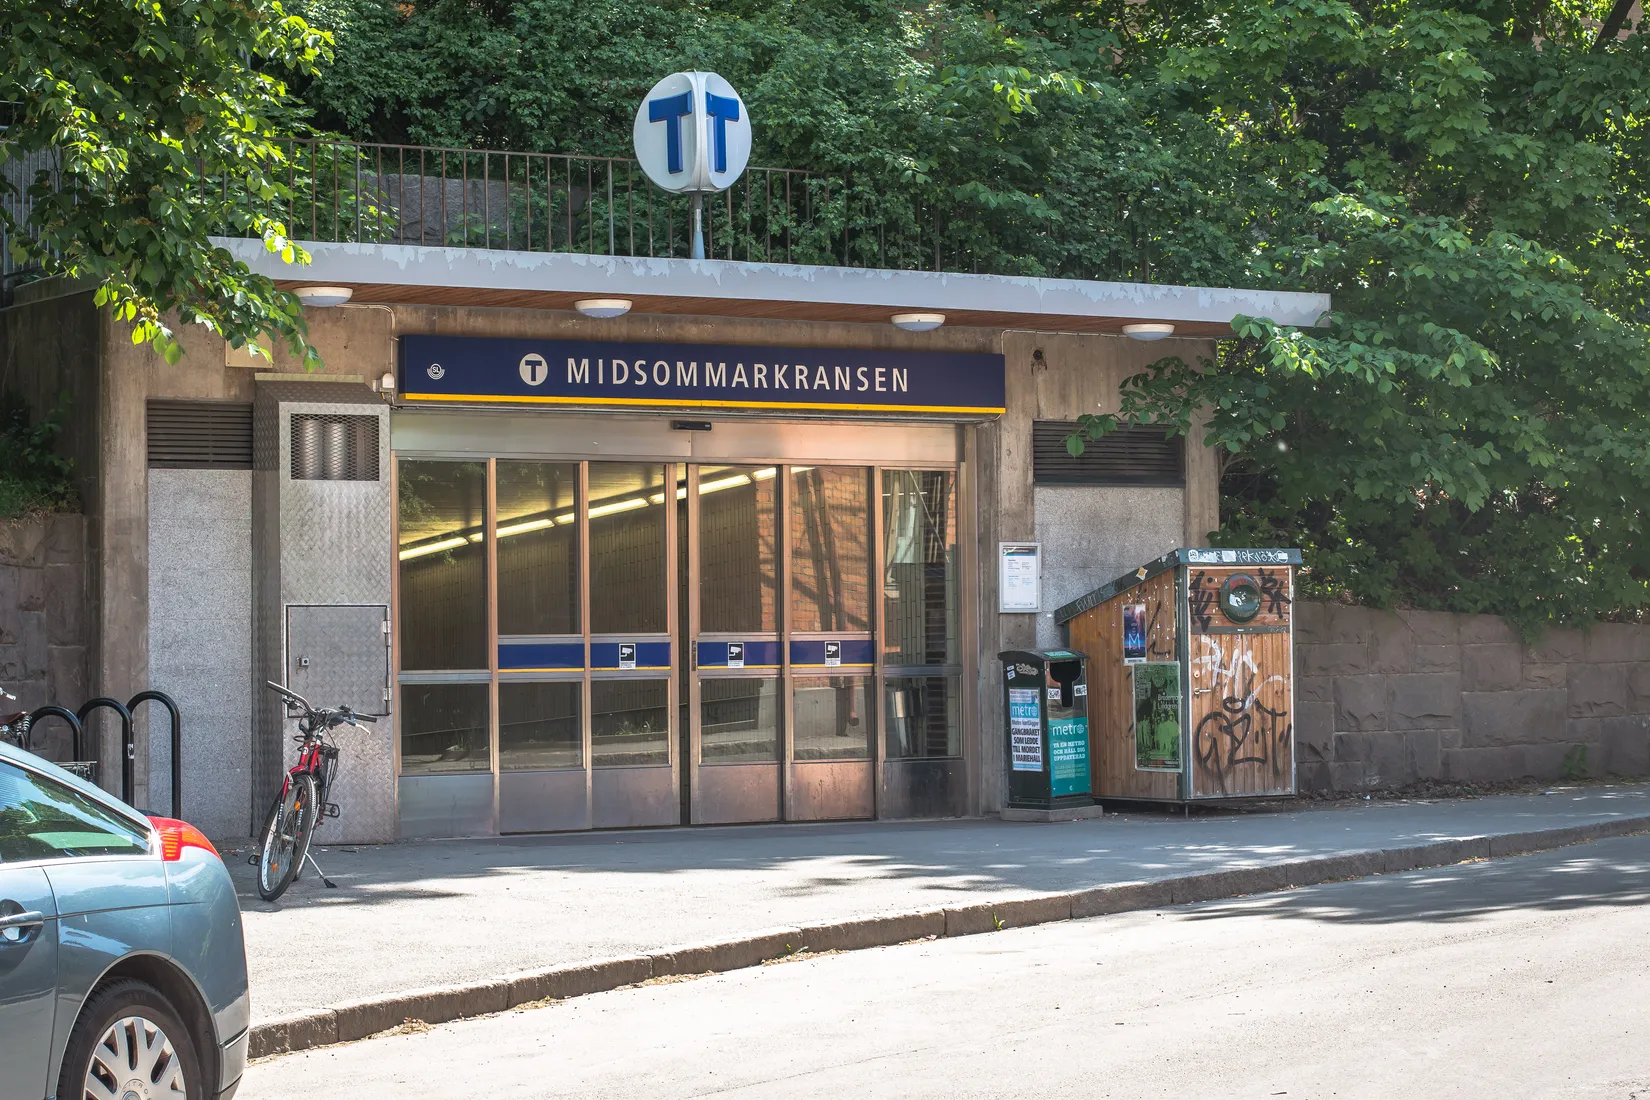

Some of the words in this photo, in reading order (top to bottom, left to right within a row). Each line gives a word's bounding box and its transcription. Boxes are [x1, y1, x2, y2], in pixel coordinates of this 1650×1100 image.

[648, 90, 692, 174] T
[705, 91, 740, 174] T
[567, 357, 908, 392] MIDSOMMARKRANSEN
[1012, 704, 1038, 717] metro
[1025, 737, 1039, 745] LEDDE
[1052, 723, 1085, 736] metro
